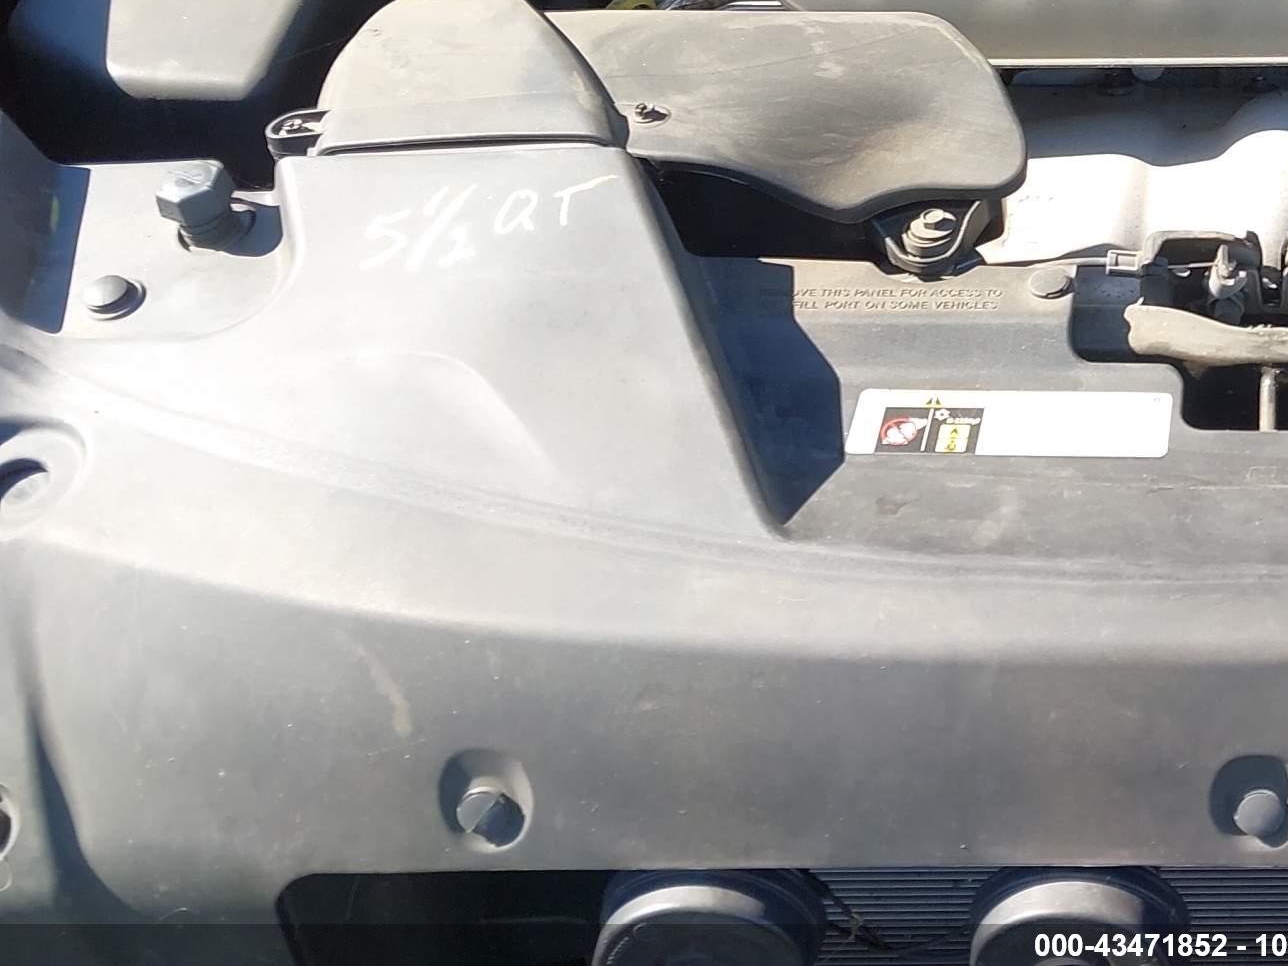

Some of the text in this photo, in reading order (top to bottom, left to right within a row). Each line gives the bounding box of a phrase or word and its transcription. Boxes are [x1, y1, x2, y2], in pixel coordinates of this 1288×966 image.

[494, 174, 620, 235] QT
[820, 288, 850, 298] THIS
[853, 288, 897, 298] PANEL
[900, 288, 927, 298] FOR
[930, 288, 983, 298] ACCESS
[985, 288, 1003, 298] TO
[792, 300, 819, 310] FILL
[824, 300, 860, 310] PORT
[865, 300, 886, 310] ON
[890, 300, 929, 310] SOME
[934, 300, 998, 310] VEHICLES
